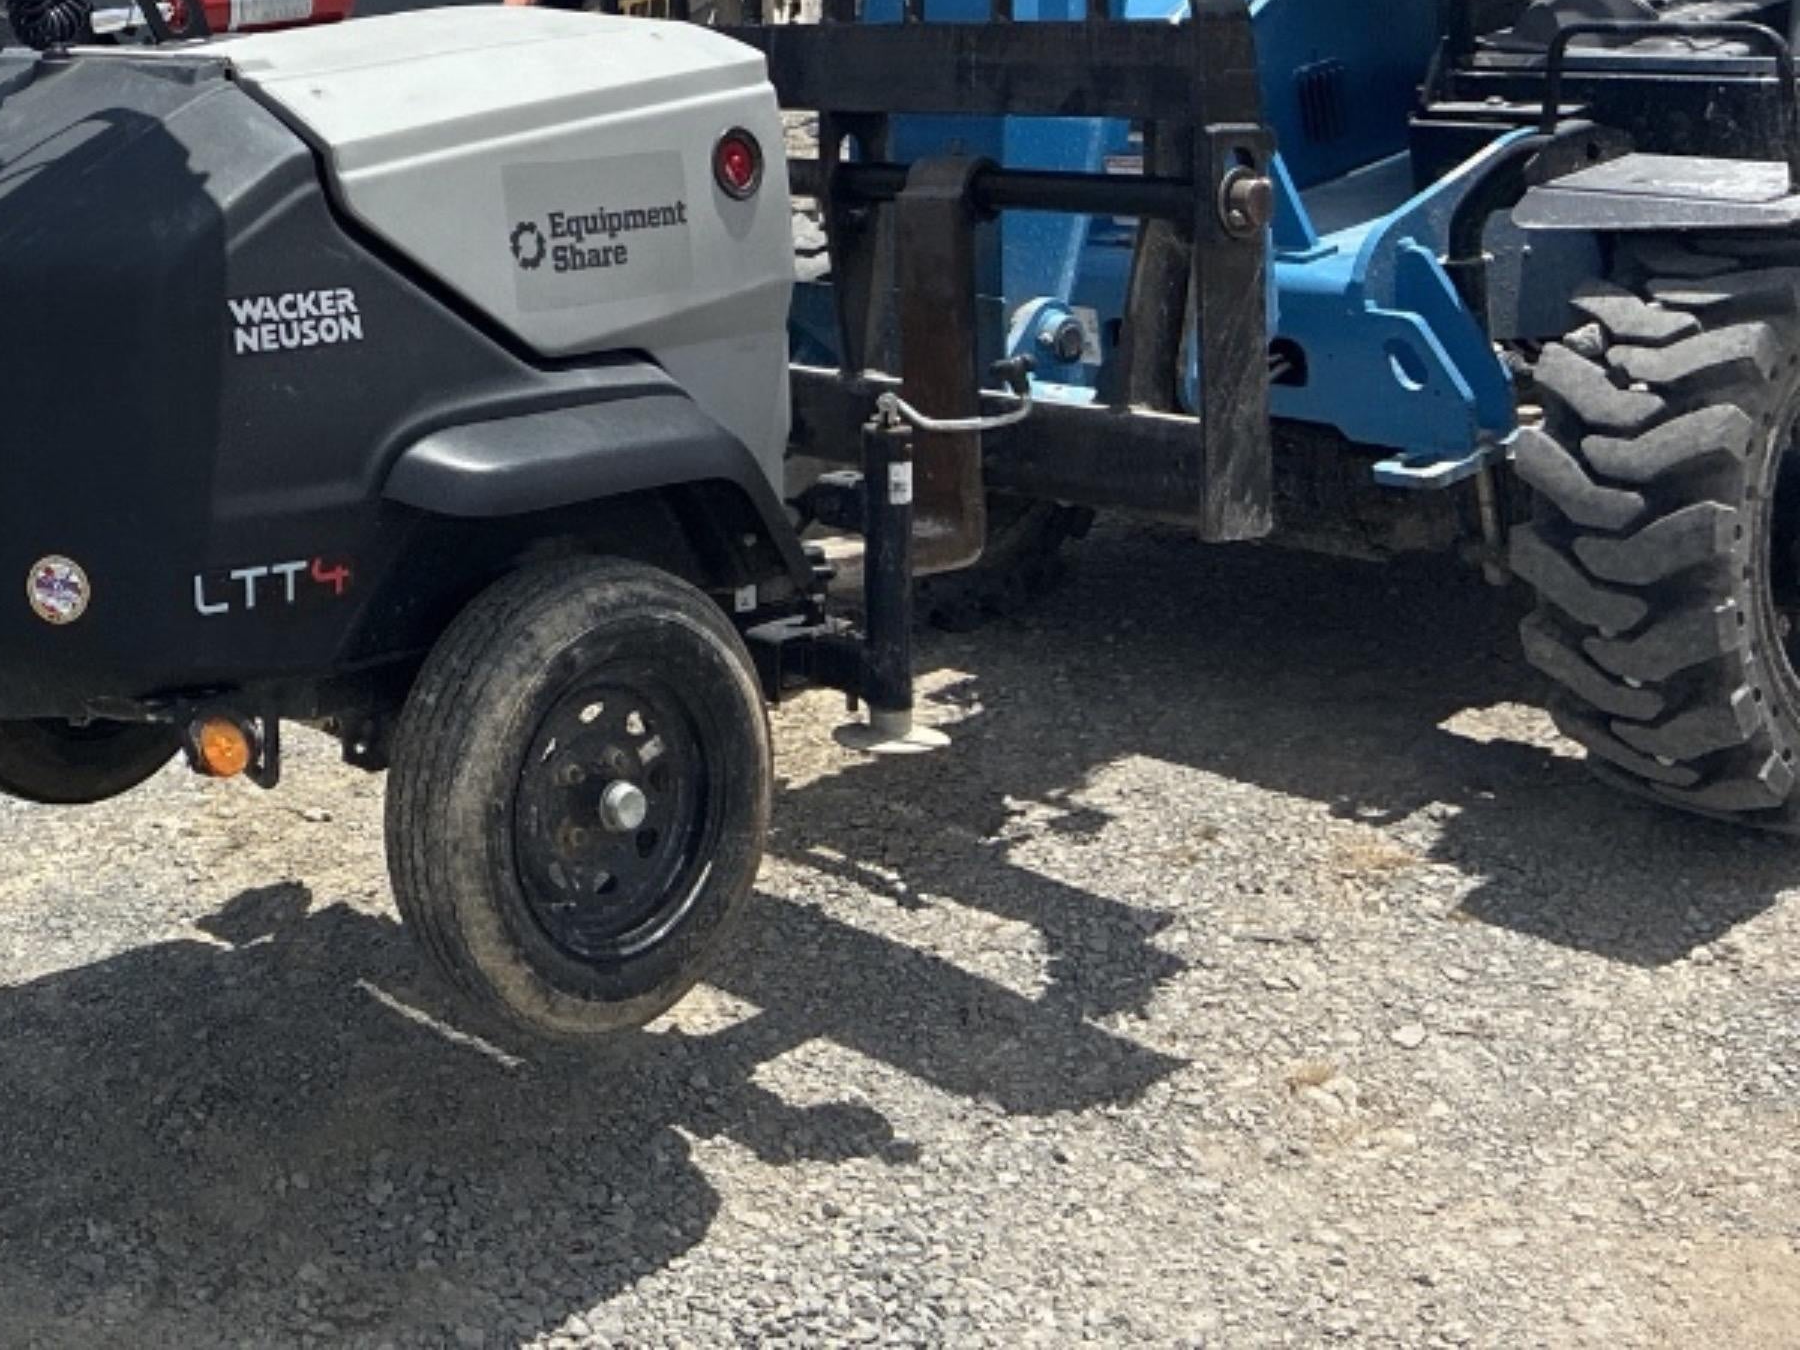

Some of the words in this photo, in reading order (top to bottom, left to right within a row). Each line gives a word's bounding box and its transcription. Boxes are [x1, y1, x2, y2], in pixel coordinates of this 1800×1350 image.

[547, 200, 688, 242] Equipment
[551, 243, 628, 273] Share
[227, 287, 360, 325] WACKER
[234, 314, 364, 355] NEUSON
[194, 557, 349, 616] LTT4
